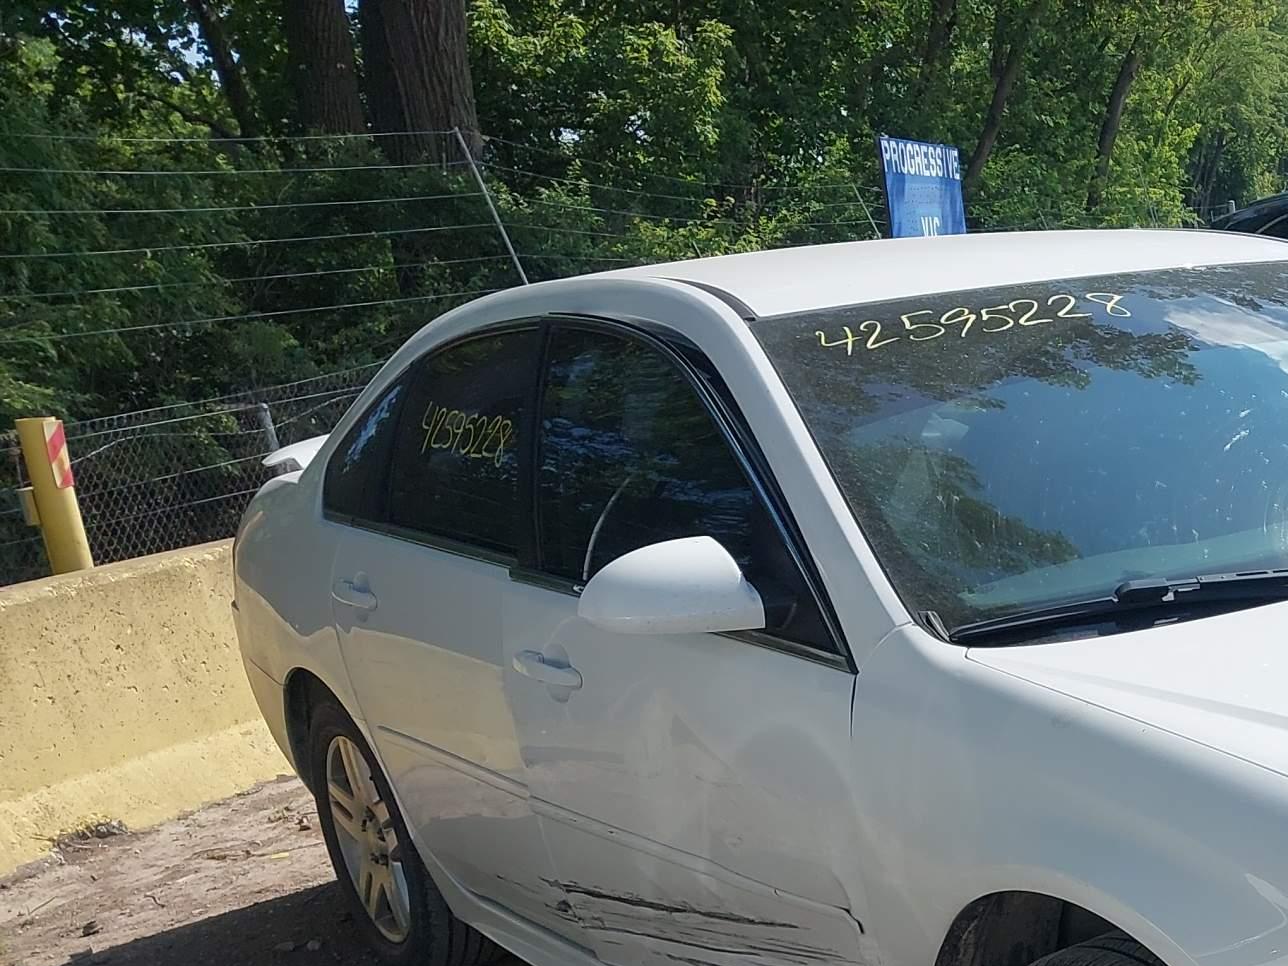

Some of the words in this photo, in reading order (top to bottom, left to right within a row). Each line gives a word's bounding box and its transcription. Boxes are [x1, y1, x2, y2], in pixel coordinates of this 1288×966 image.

[880, 140, 961, 180] PROGRESSIVE
[815, 292, 1132, 356] 42595228
[421, 401, 513, 468] 42595228
